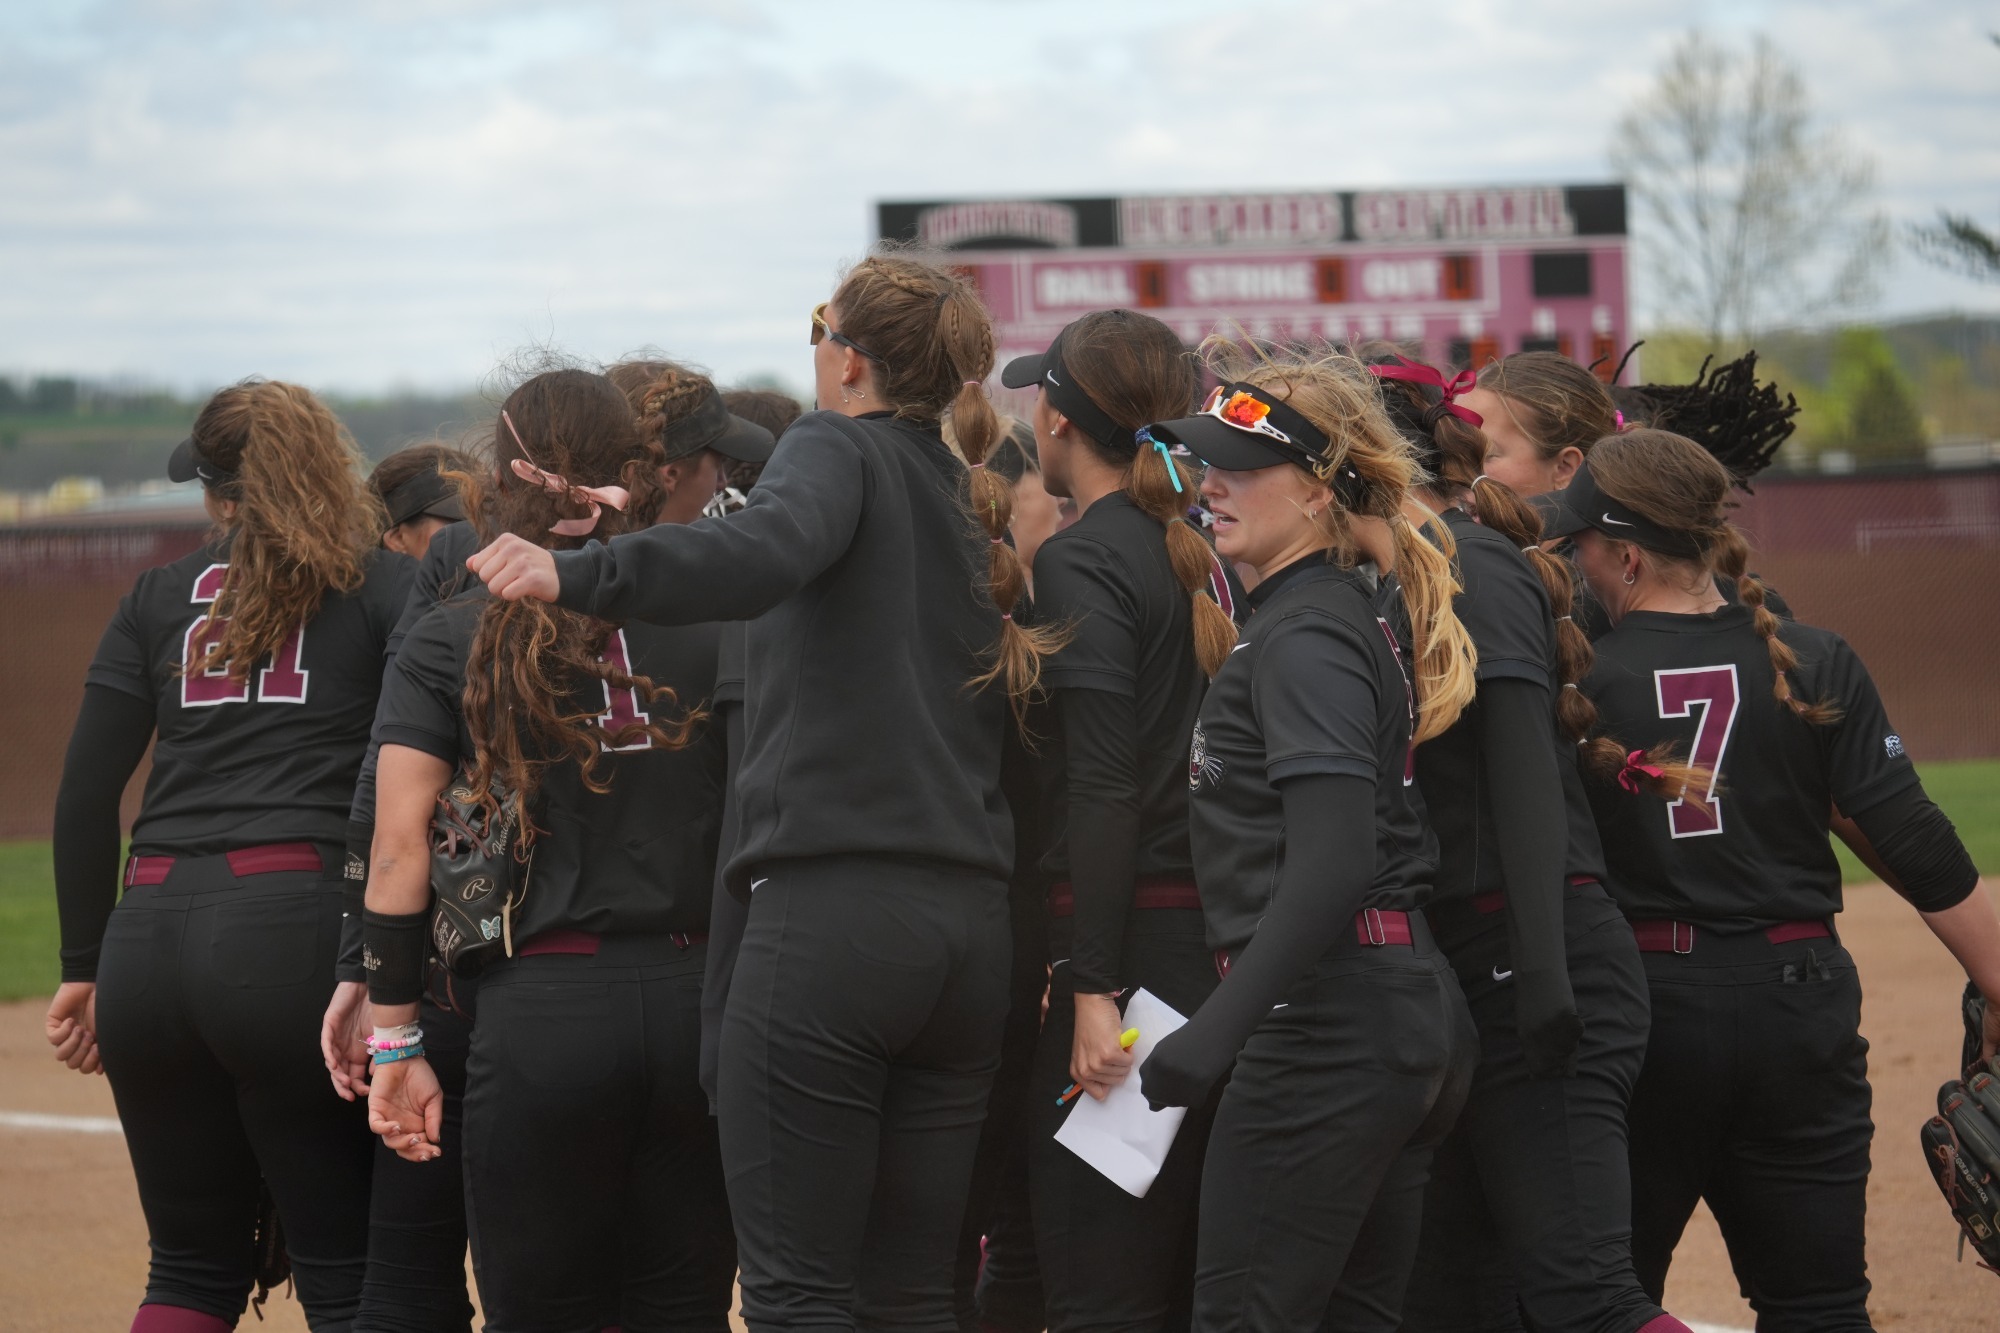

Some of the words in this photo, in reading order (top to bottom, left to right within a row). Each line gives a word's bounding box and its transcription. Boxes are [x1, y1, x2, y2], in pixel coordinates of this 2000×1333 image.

[1038, 267, 1132, 306] BALL
[1187, 263, 1316, 302] STRIKE
[1363, 260, 1440, 298] OUT
[598, 628, 652, 752] 1
[1654, 664, 1740, 839] 7
[1956, 1157, 1969, 1175] GOLD
